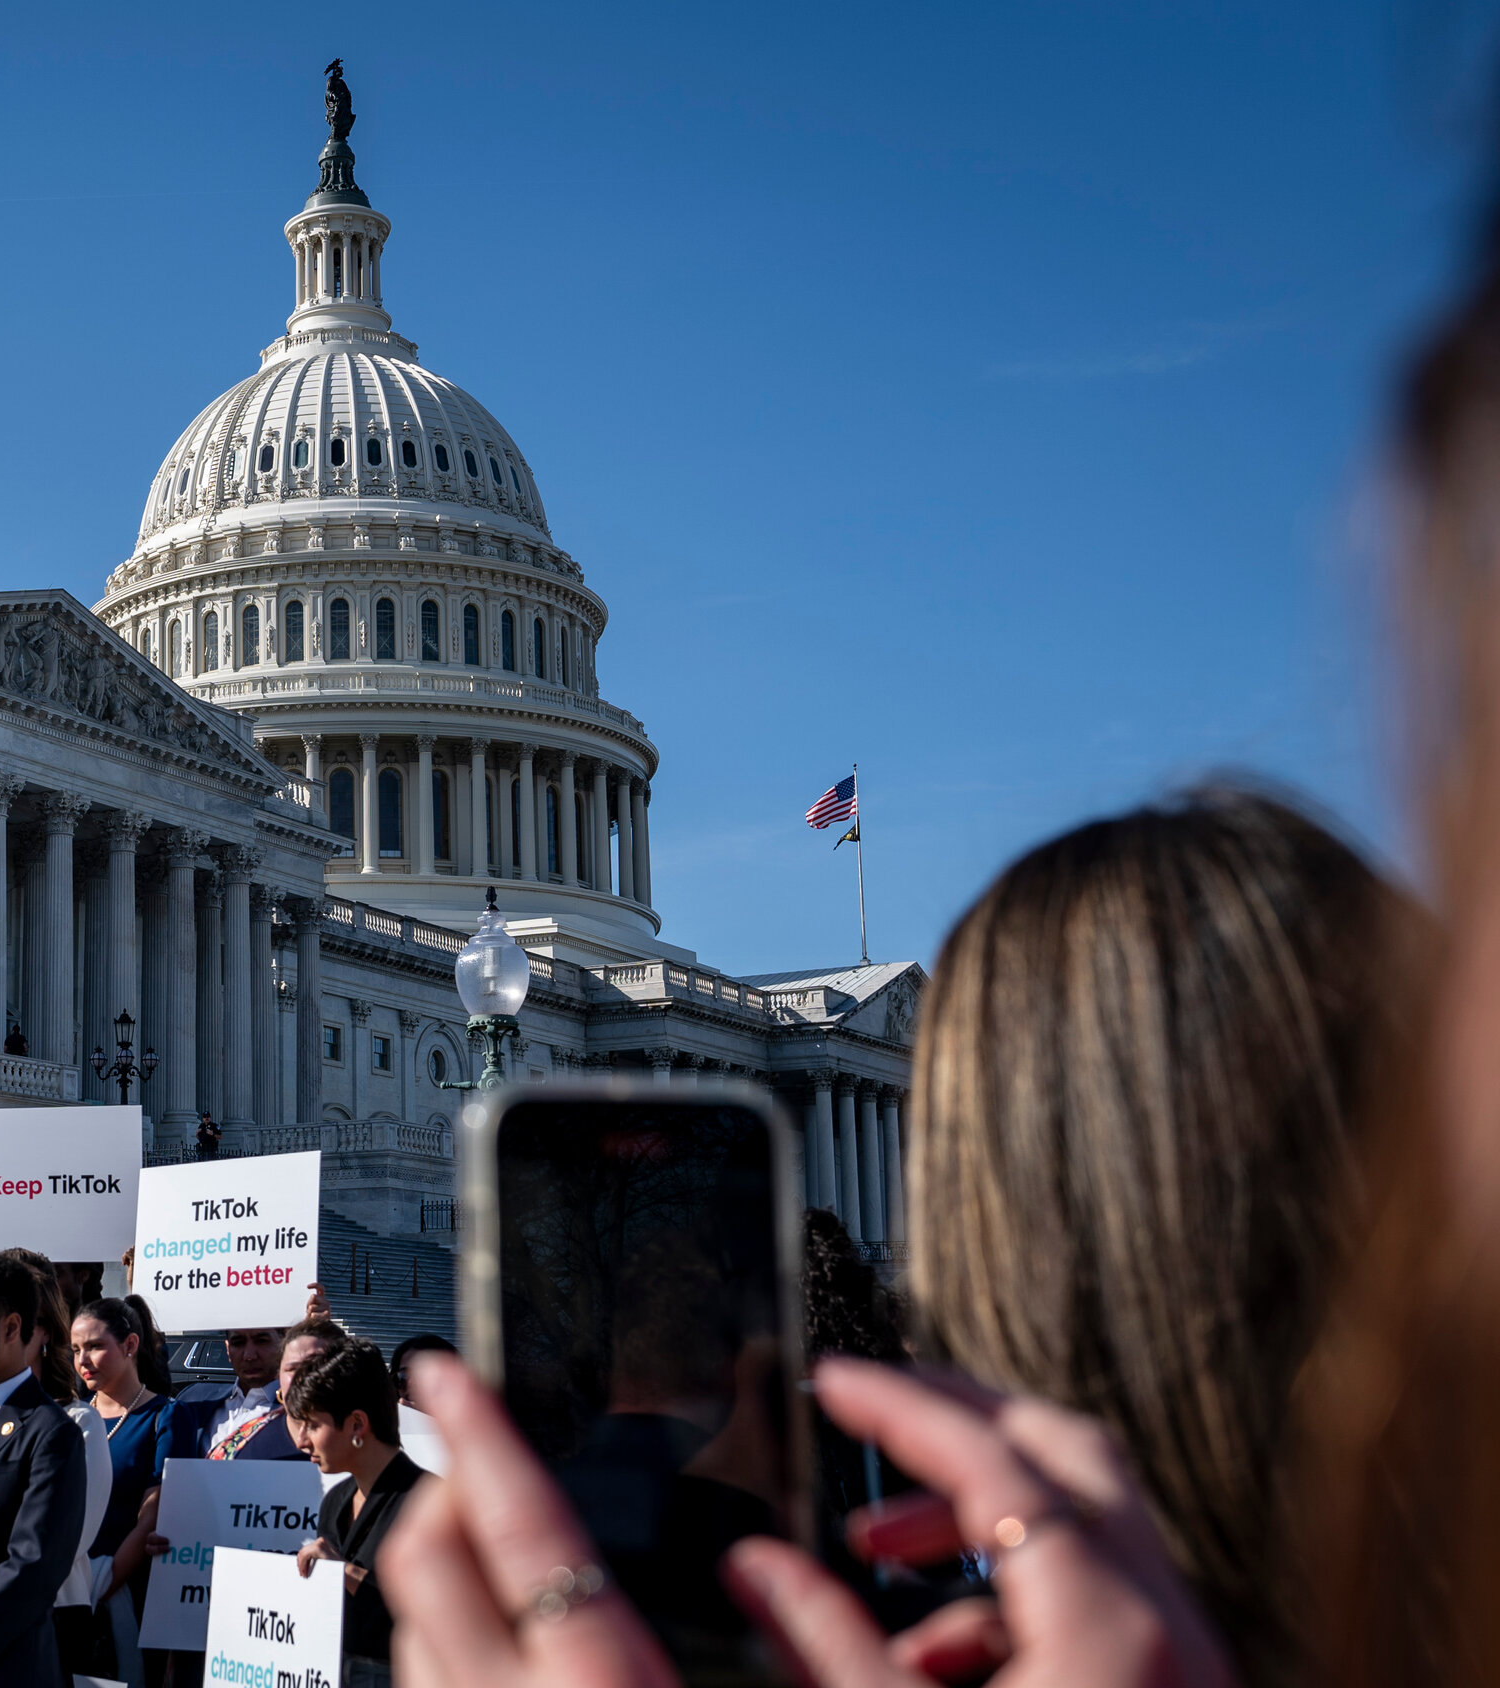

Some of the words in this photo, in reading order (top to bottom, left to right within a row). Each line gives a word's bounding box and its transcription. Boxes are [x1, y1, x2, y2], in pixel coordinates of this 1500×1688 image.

[48, 1174, 121, 1194] TikTok
[192, 1197, 259, 1221] TikTok
[143, 1232, 232, 1261] changed
[236, 1234, 270, 1256] my
[274, 1226, 308, 1250] life
[153, 1270, 183, 1291] for
[187, 1268, 221, 1289] the
[226, 1264, 294, 1287] better
[230, 1503, 318, 1530] TikTok
[247, 1606, 295, 1645] TikTok
[211, 1650, 274, 1688] changed
